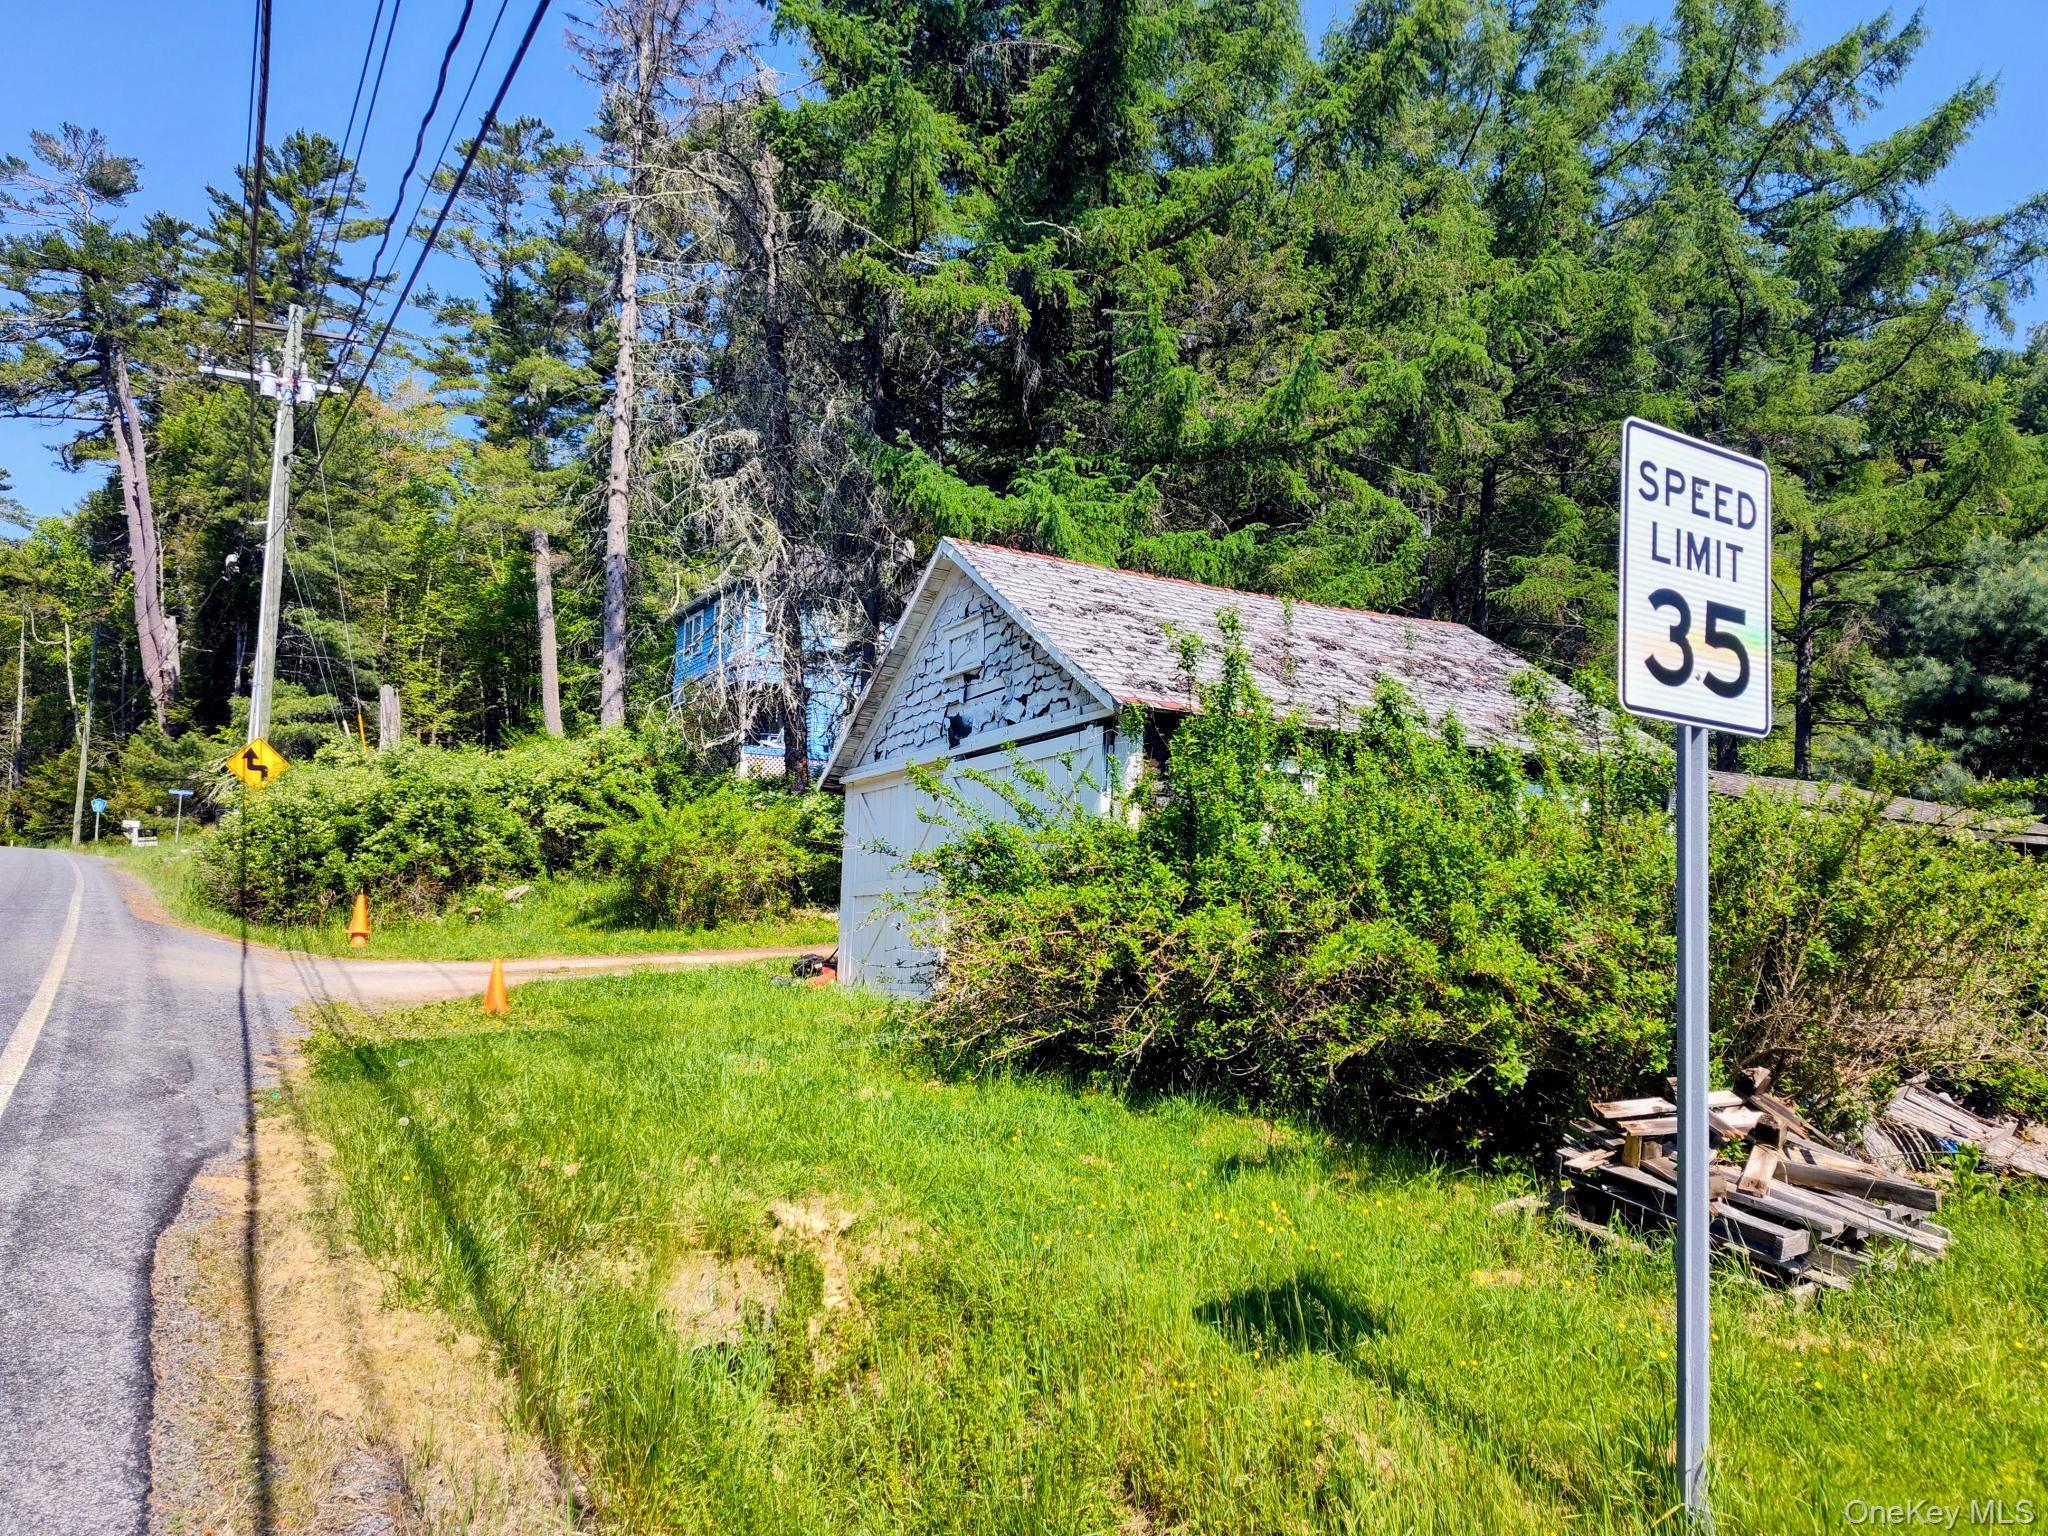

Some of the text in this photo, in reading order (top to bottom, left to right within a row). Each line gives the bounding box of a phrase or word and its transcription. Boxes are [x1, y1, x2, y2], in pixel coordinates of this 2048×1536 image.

[1638, 459, 1758, 531] SPEED
[1651, 520, 1744, 583] LIMIT
[1644, 587, 1751, 699] 35
